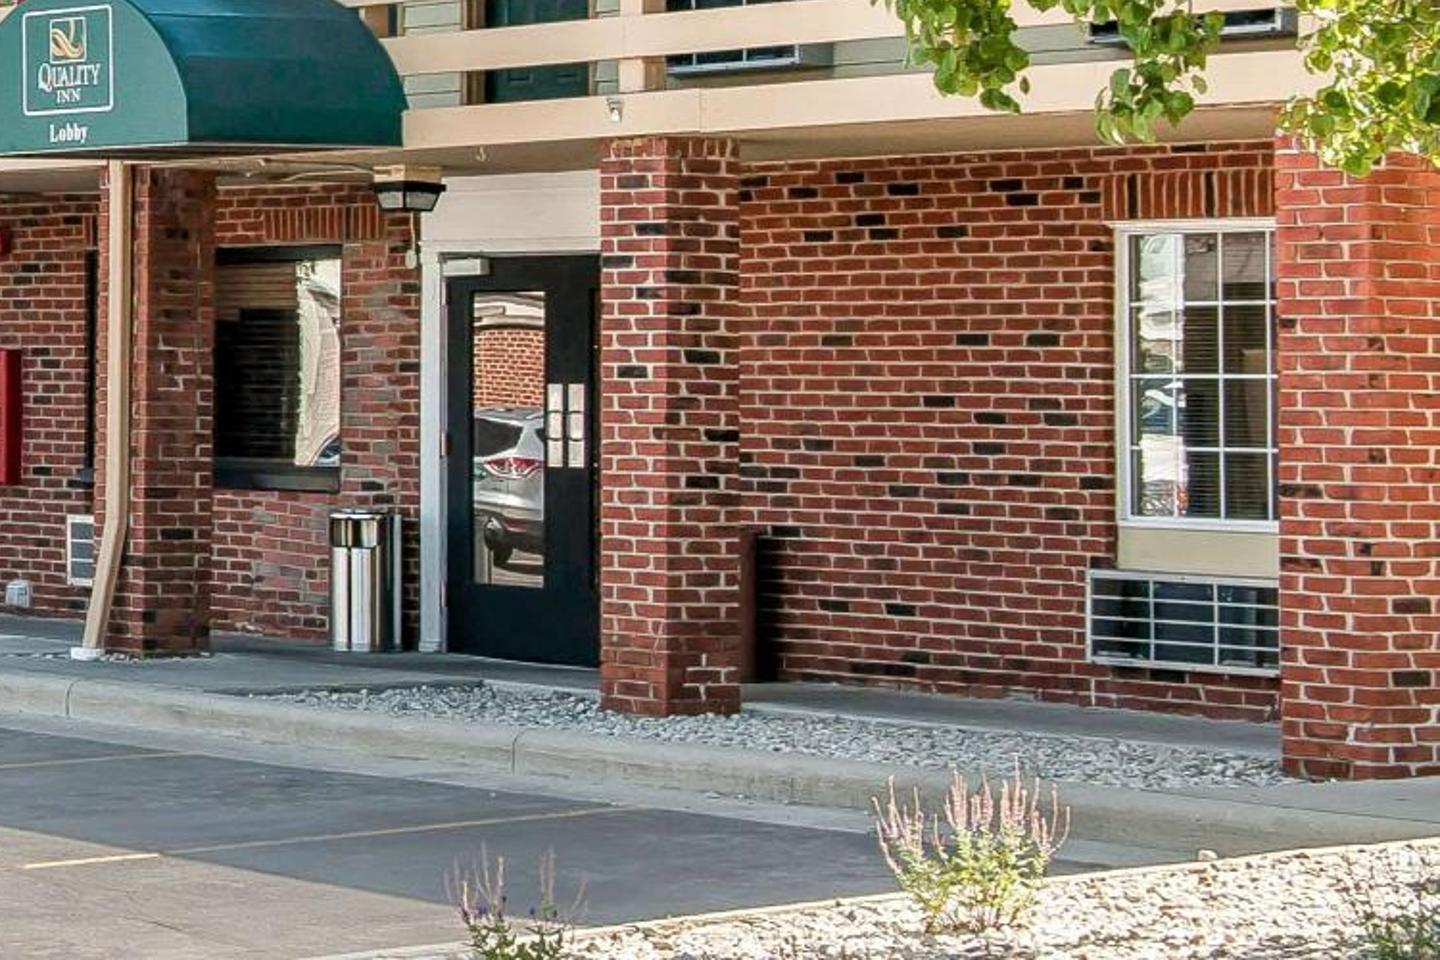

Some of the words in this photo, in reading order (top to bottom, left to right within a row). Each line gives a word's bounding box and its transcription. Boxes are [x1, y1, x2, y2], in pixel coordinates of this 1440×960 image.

[38, 63, 101, 93] QUALITY
[56, 87, 81, 104] INN
[49, 122, 89, 145] Lobby
